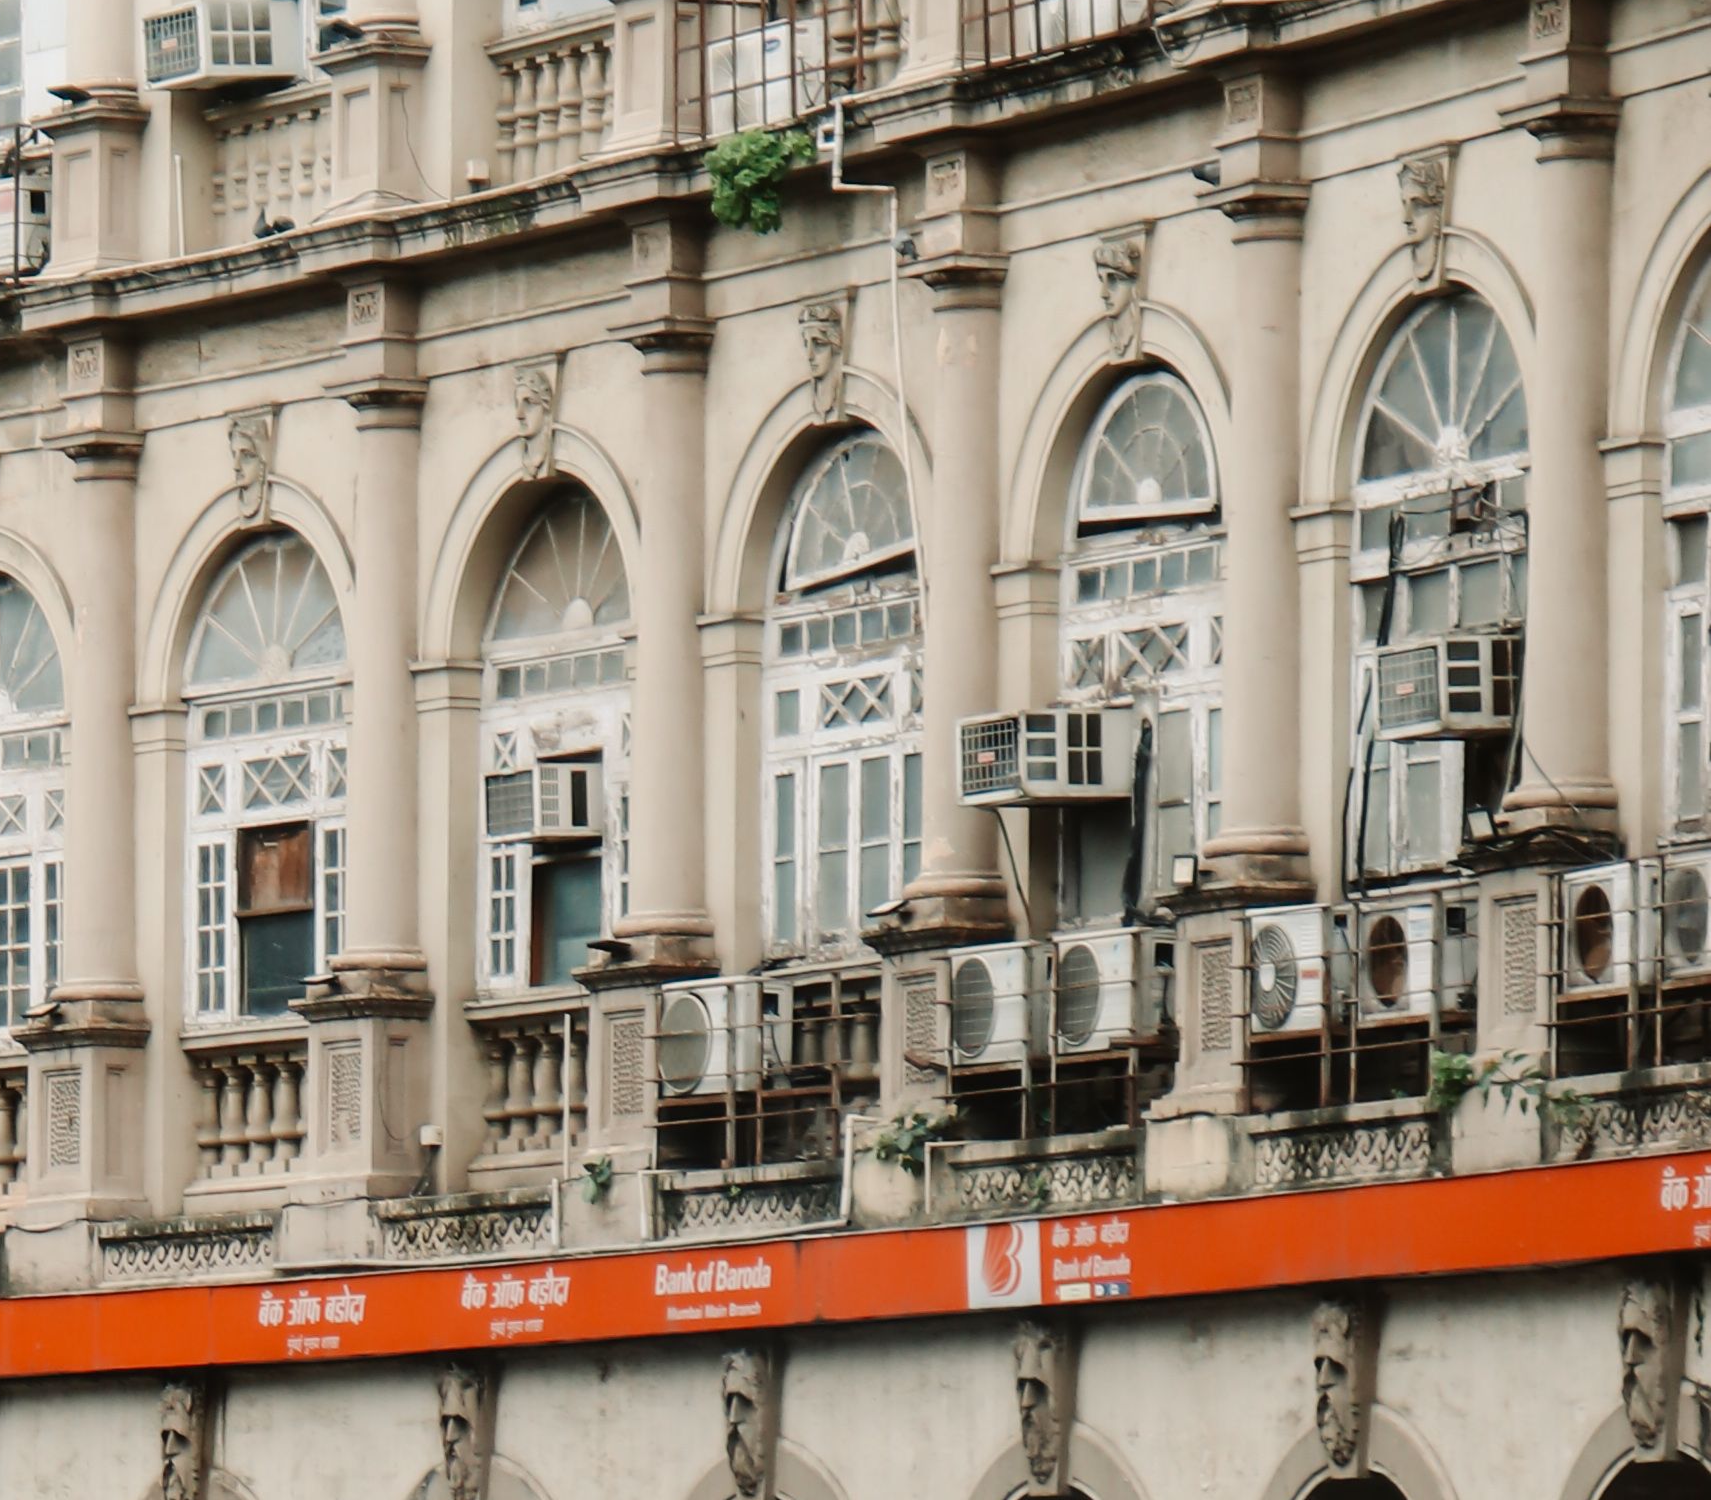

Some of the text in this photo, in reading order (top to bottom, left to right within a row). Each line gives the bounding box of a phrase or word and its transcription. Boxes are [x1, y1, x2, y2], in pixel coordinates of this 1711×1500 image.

[654, 1256, 771, 1296] Bank of Baroda
